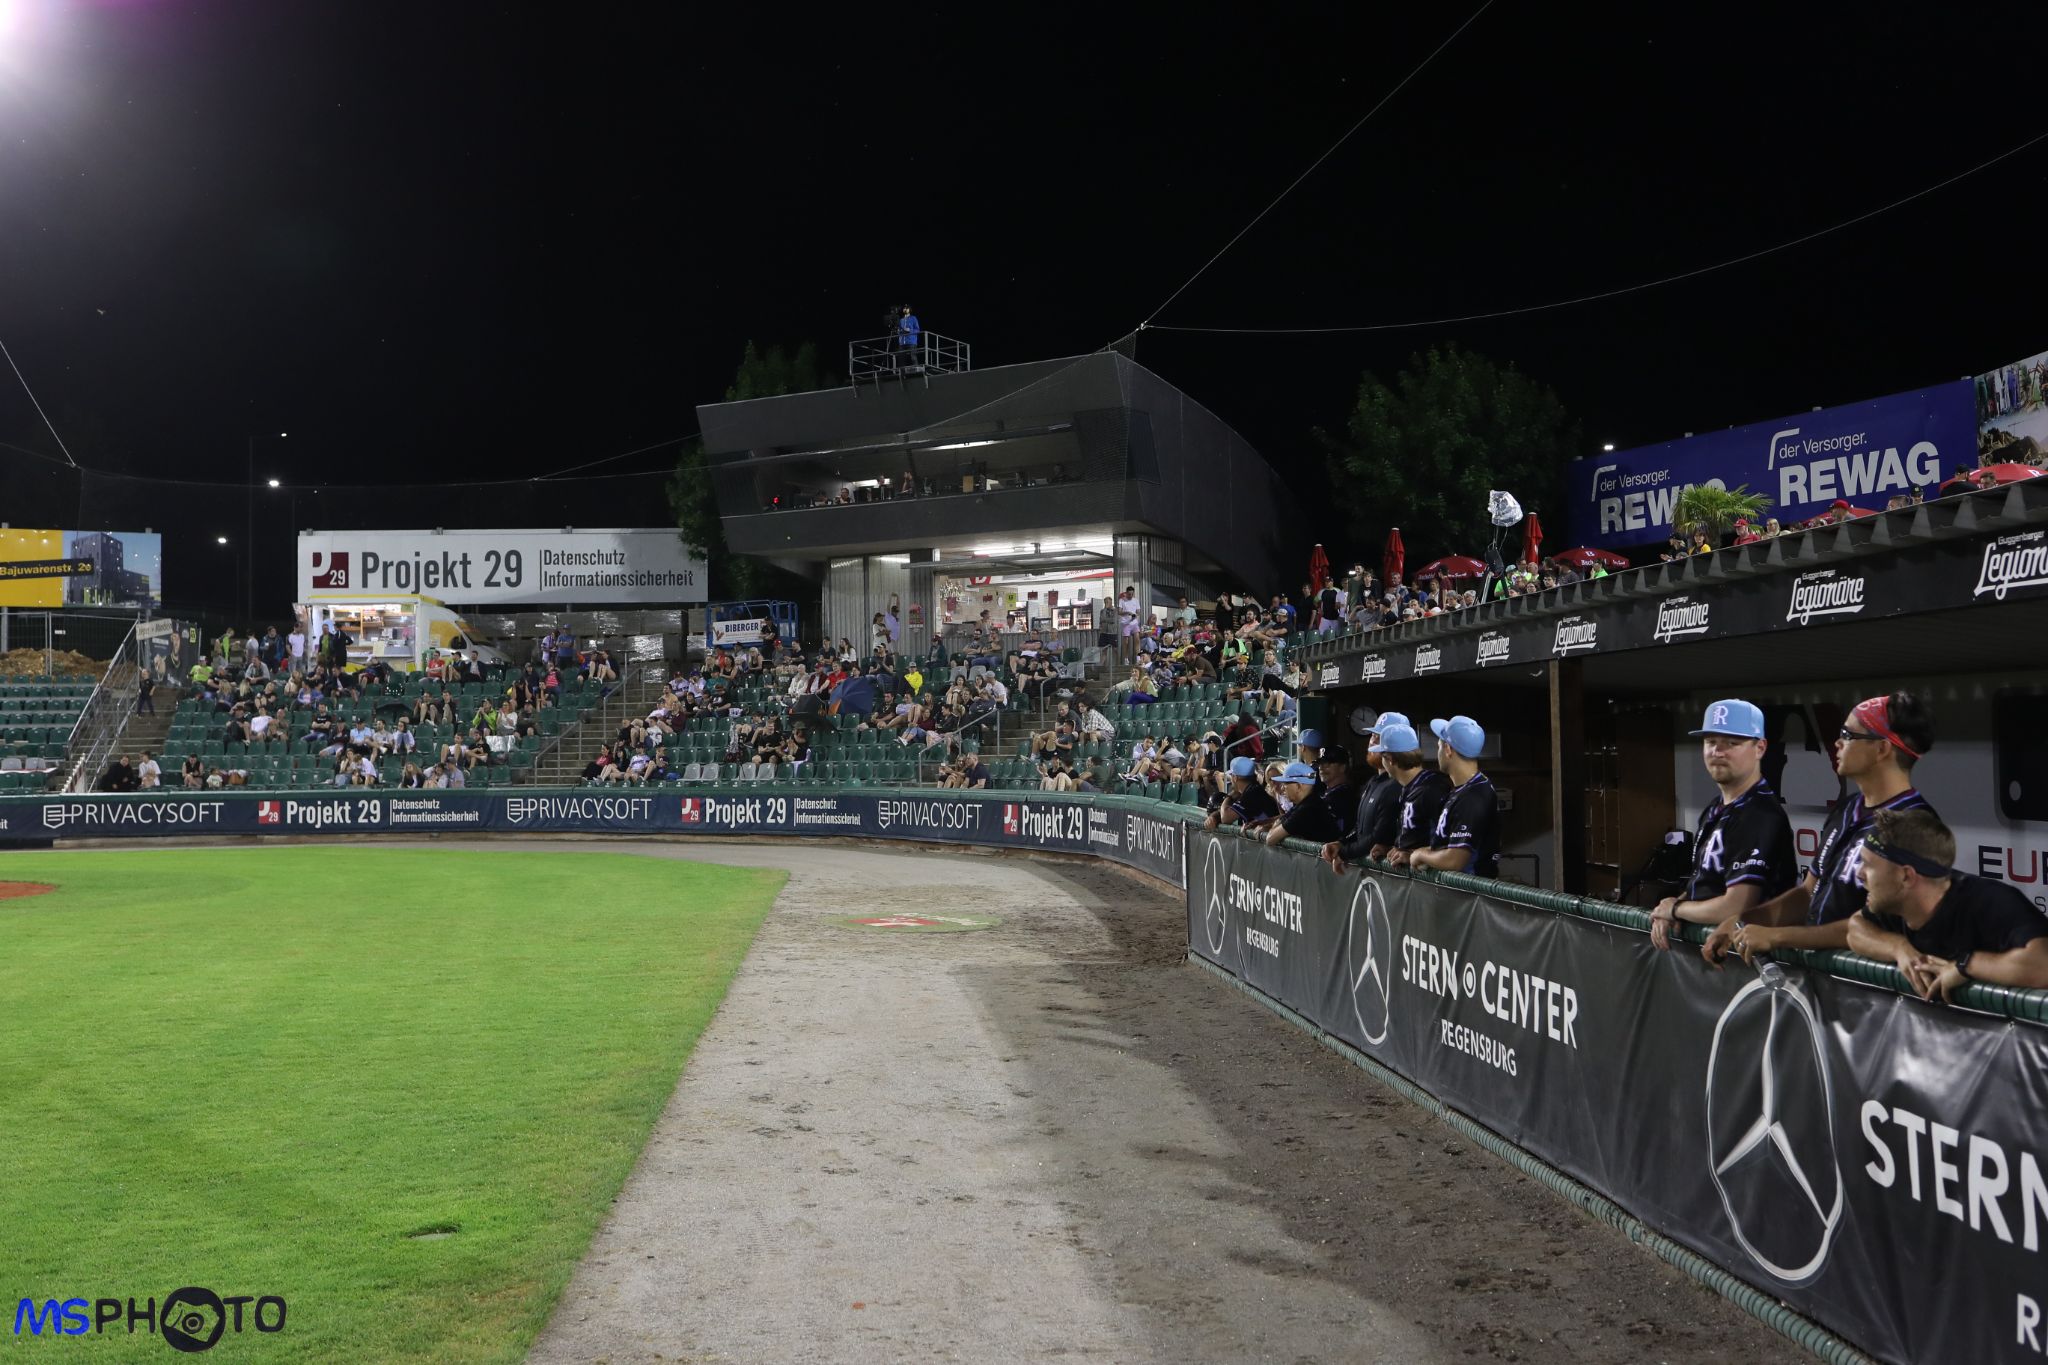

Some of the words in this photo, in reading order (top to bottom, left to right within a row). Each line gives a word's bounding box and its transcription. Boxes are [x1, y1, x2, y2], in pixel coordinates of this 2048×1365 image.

[1779, 443, 1800, 459] der
[1803, 432, 1867, 455] Versorger.
[1600, 478, 1617, 492] der
[1619, 468, 1671, 488] Versorger.
[1779, 441, 1941, 507] REWAG
[1600, 478, 1727, 534] REW
[543, 549, 625, 566] Datenschutz
[329, 570, 346, 586] 29
[361, 551, 472, 594] Projekt
[483, 550, 523, 588] 29
[543, 570, 694, 587] Informationssicherheit
[1786, 576, 1864, 625] Legionäre
[725, 622, 759, 633] BIBERGER
[1654, 602, 1709, 643] Legionäre
[1552, 620, 1597, 656] Legionäre
[71, 803, 224, 824] PRIVACYSOFT
[268, 811, 279, 822] 29
[287, 801, 351, 828] Projekt
[357, 800, 381, 823] 29
[392, 799, 440, 810] Datenschutz
[392, 811, 479, 823] Informationssicherheit
[529, 798, 652, 820] PRIVACYSOFT
[690, 810, 699, 821] 29
[705, 797, 761, 828] Projekt
[766, 797, 786, 824] 29
[796, 797, 837, 810] Datenschutz
[893, 801, 982, 830] PRIVACYSOFT
[1022, 805, 1063, 844] Projekt
[1067, 806, 1083, 840] 29
[1229, 872, 1255, 914] STERN
[1263, 885, 1303, 934] CENTER
[1402, 934, 1458, 1000] STERN
[1480, 960, 1578, 1050] CENTER
[1441, 1018, 1517, 1077] REGENSBURG
